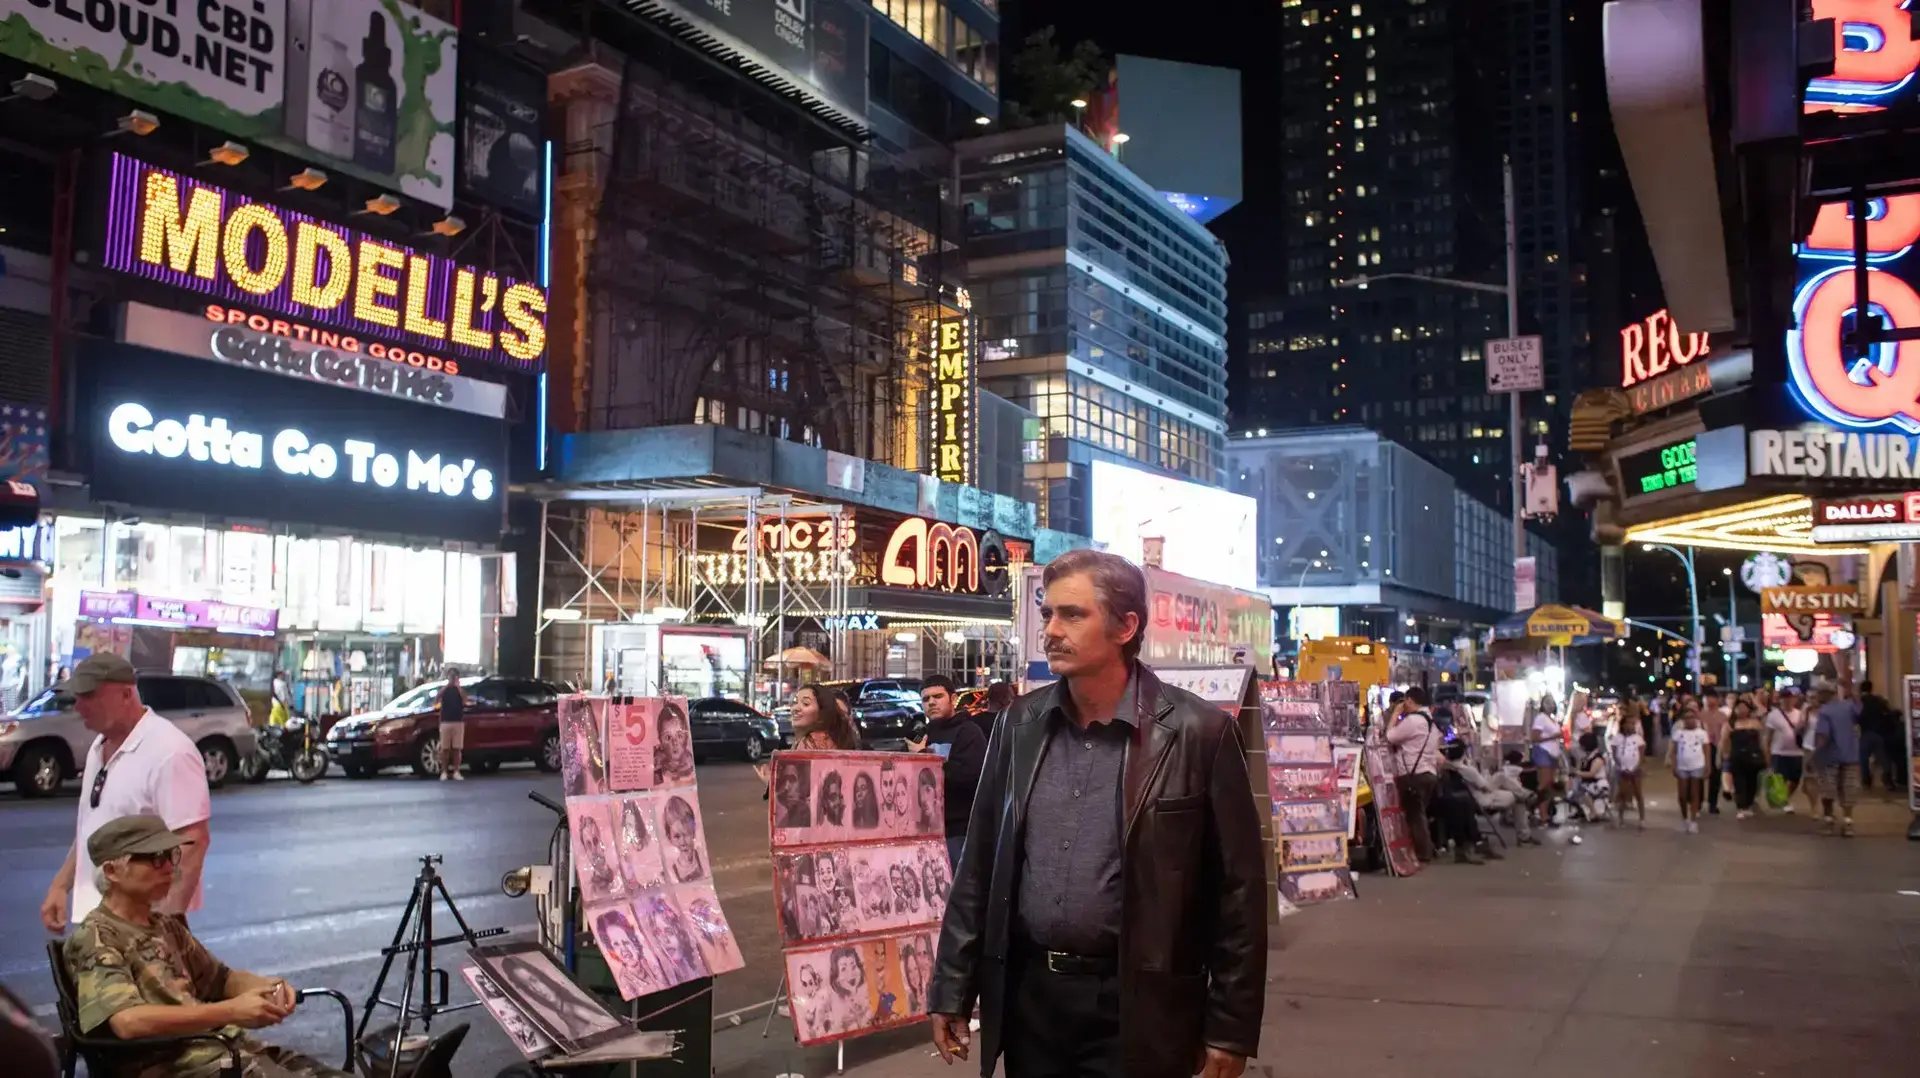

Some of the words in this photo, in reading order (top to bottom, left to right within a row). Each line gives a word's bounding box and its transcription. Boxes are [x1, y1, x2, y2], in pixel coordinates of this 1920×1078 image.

[27, 0, 274, 95] LOUD.NET
[197, 0, 274, 54] CBD
[140, 171, 549, 361] MODELL'S
[205, 304, 361, 353] SPORTING
[368, 342, 460, 375] GOODS
[1493, 340, 1533, 354] BUSES
[1498, 353, 1529, 365] ONLY
[1620, 308, 1711, 388] REG
[939, 322, 964, 482] EMPIR
[108, 402, 263, 469] Gotta
[272, 428, 338, 478] Go
[344, 438, 400, 487] To
[406, 449, 493, 500] Mo's
[817, 519, 857, 548] 25
[1826, 503, 1897, 520] DALLAS
[1768, 590, 1859, 610] WESTIN
